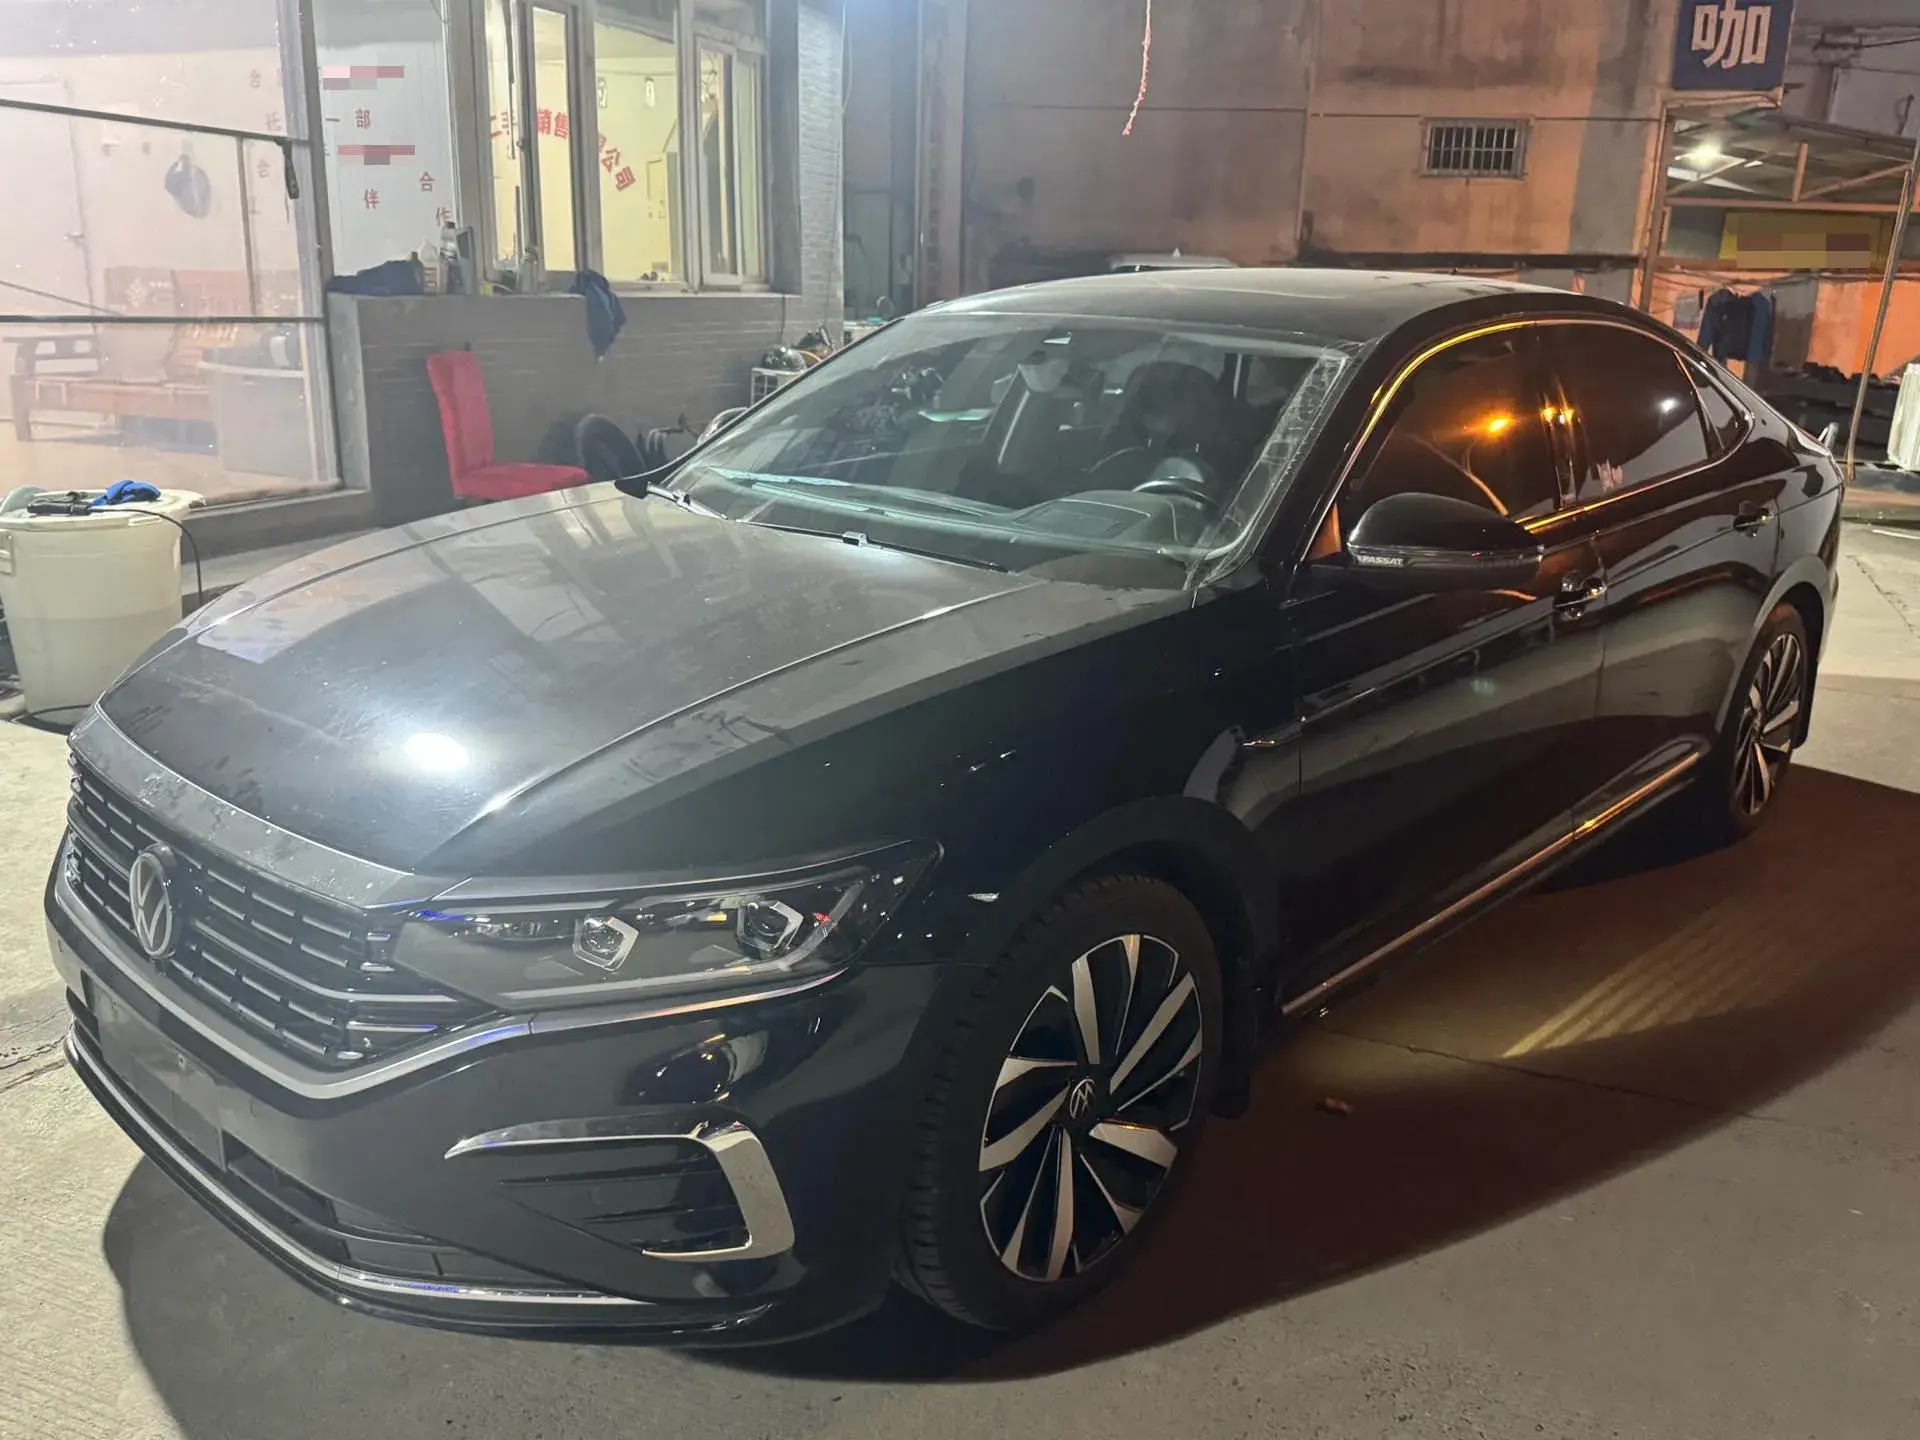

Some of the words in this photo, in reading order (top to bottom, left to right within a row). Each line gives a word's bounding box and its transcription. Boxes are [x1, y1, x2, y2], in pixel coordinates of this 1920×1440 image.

[1692, 0, 1771, 69] 咖
[355, 108, 371, 130] 部
[419, 171, 435, 192] 合
[363, 188, 379, 210] 伴
[1361, 555, 1404, 566] PASSAT
